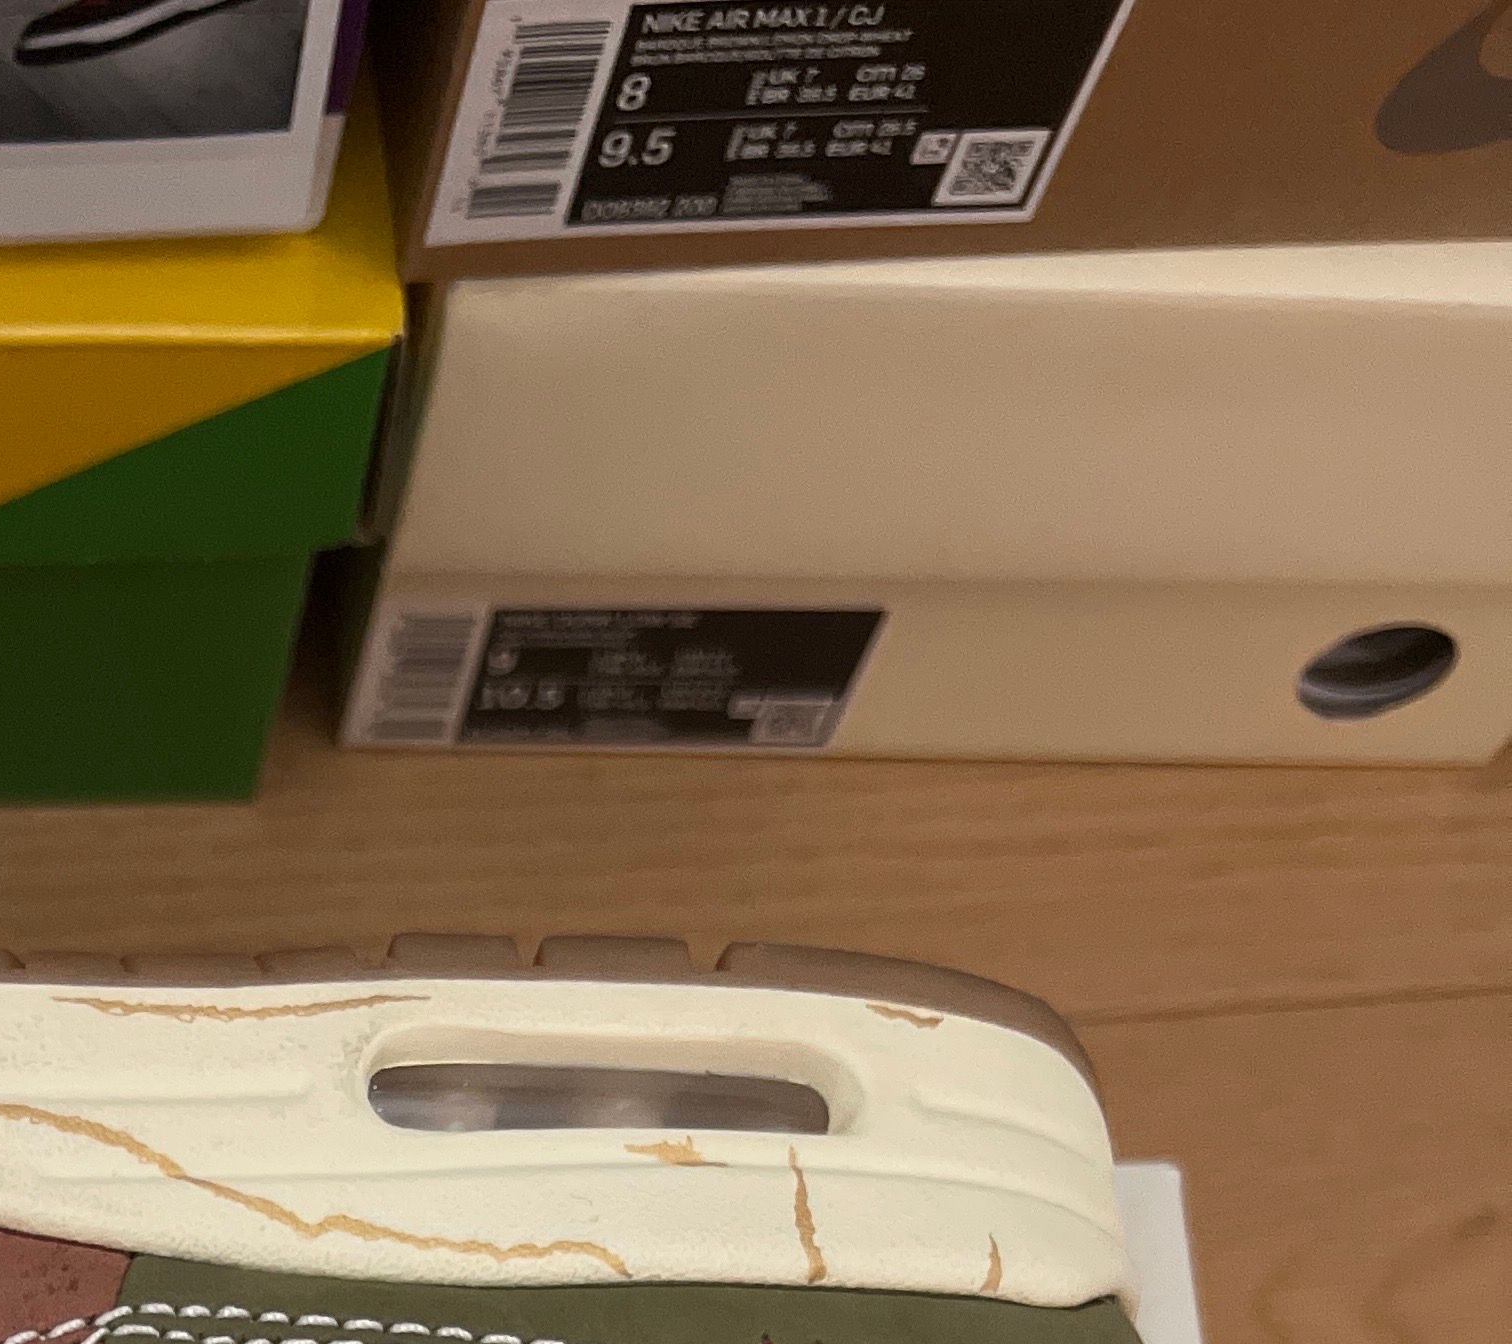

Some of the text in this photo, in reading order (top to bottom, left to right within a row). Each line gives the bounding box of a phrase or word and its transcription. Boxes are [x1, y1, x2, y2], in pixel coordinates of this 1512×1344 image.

[643, 11, 704, 34] NIKE
[706, 9, 750, 31] AIR
[754, 7, 810, 29] MAX
[848, 3, 885, 27] CJ
[616, 73, 652, 112] 8
[598, 126, 677, 169] 9.5
